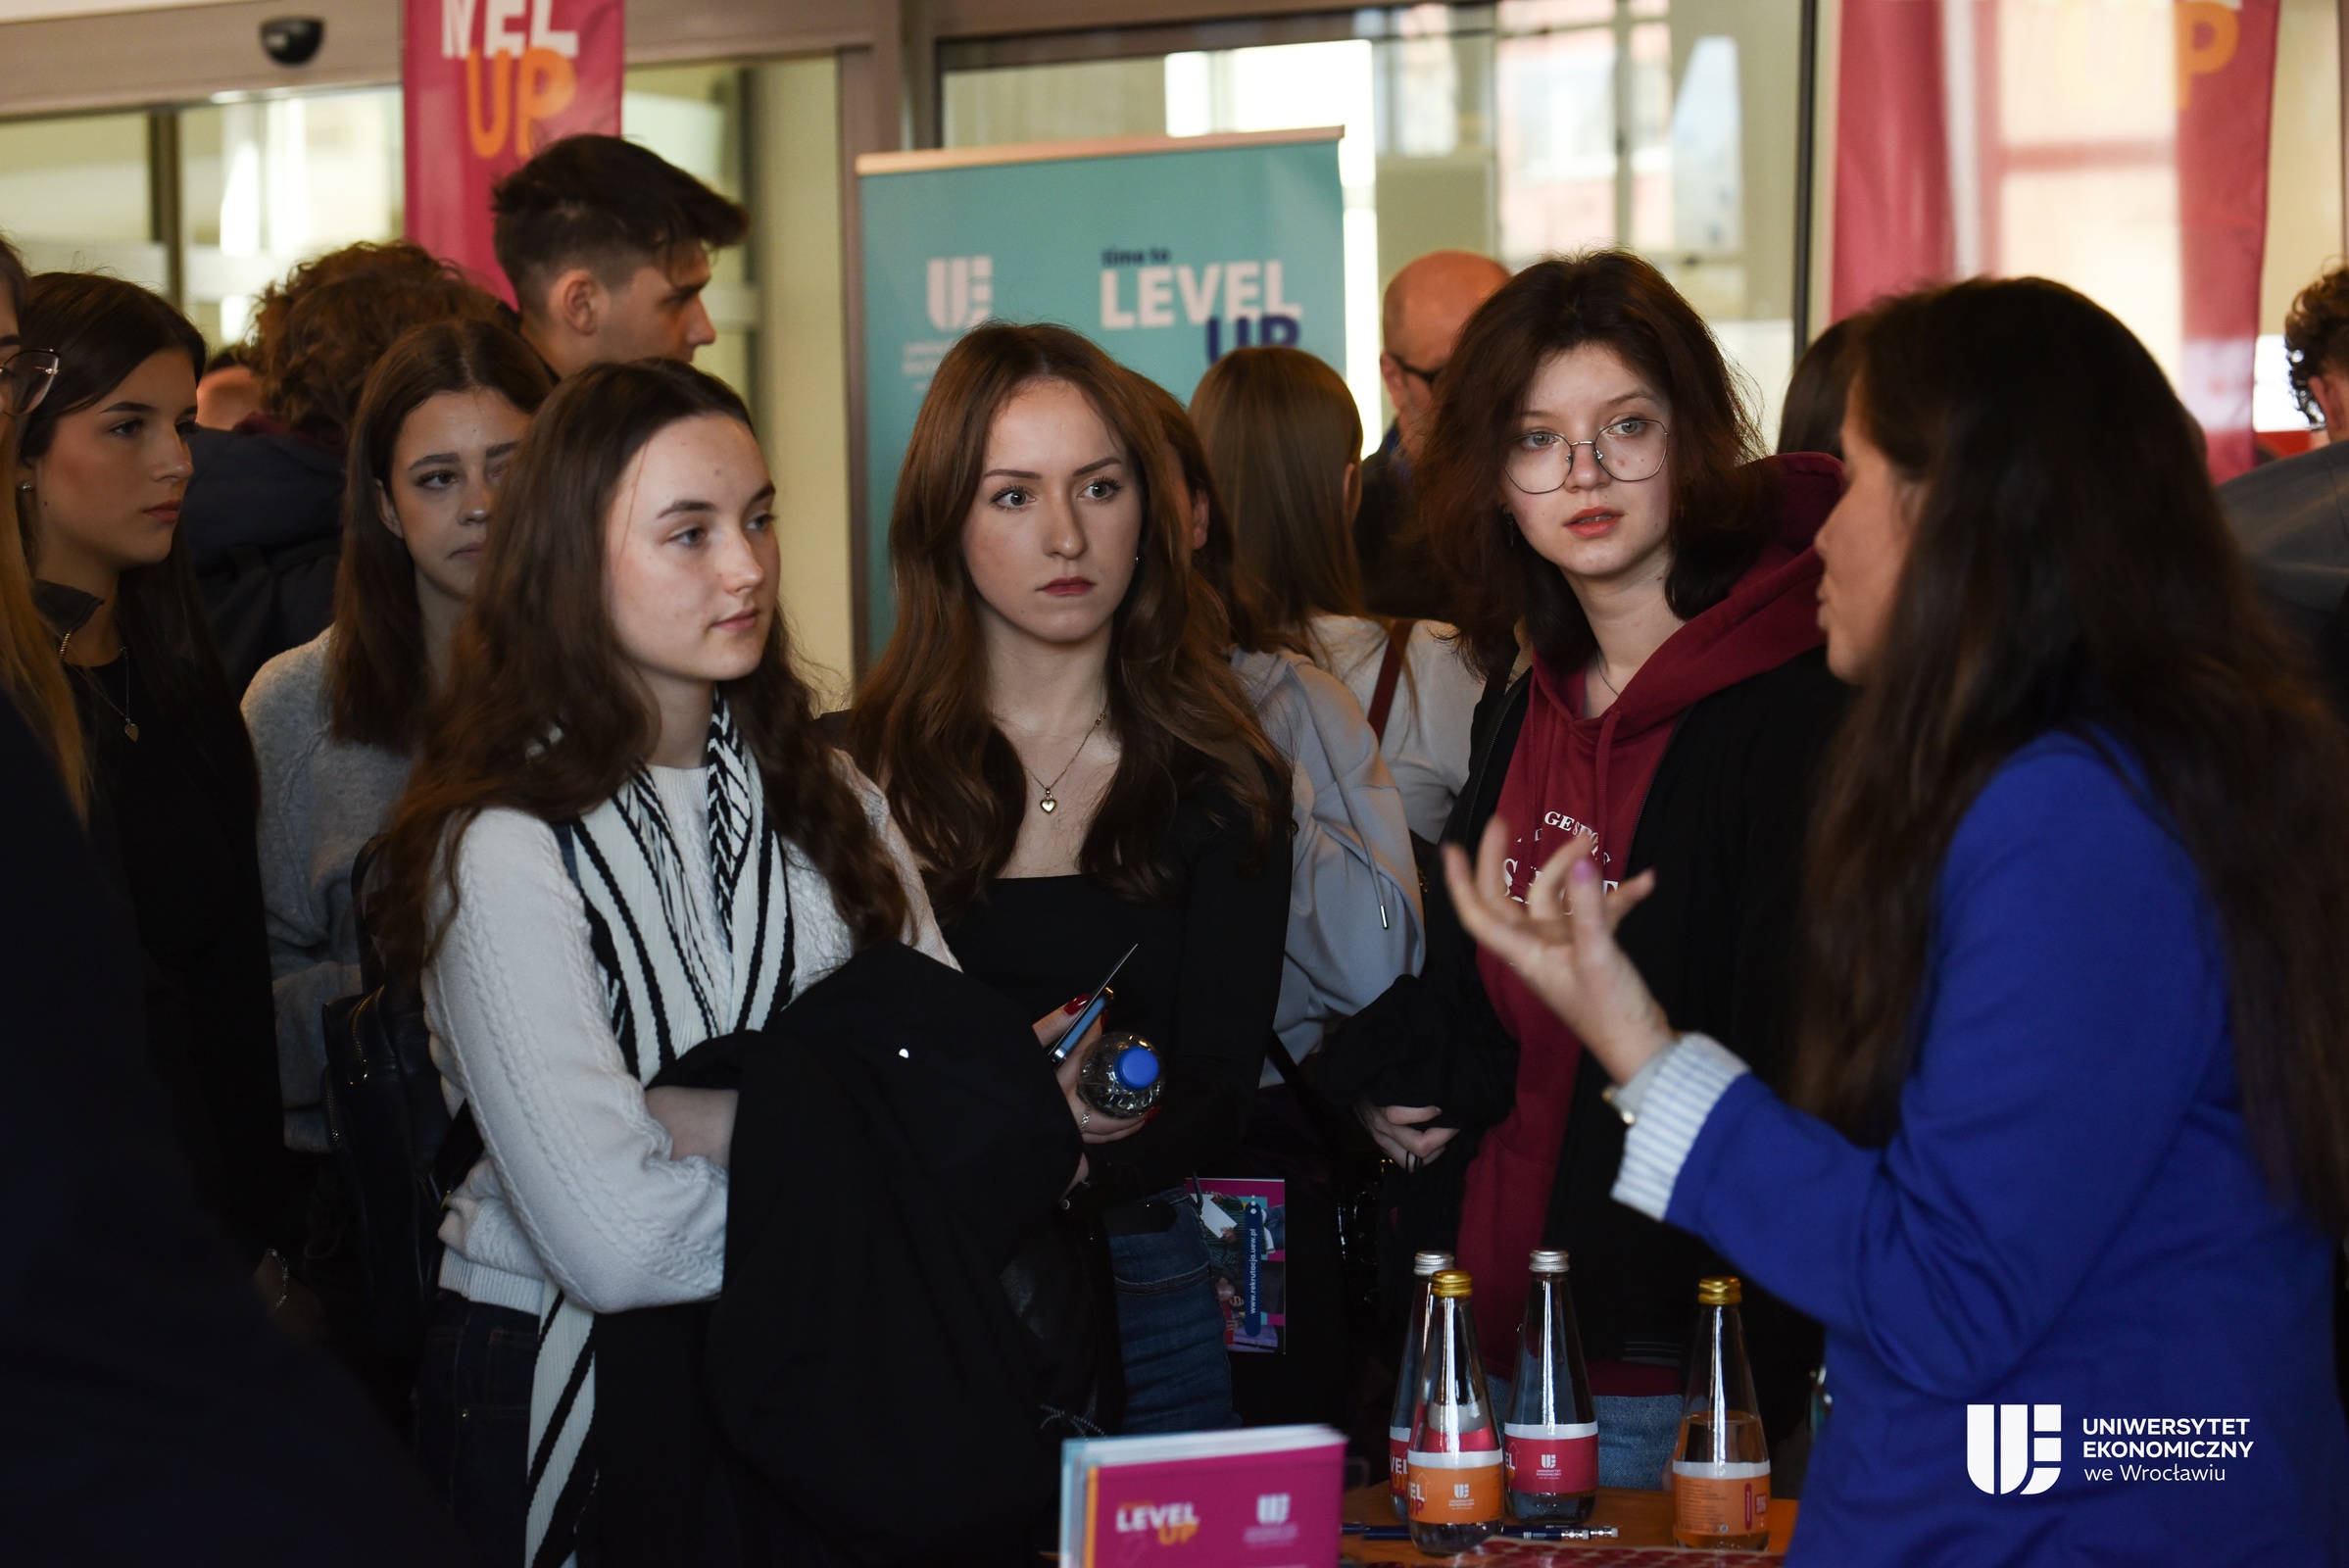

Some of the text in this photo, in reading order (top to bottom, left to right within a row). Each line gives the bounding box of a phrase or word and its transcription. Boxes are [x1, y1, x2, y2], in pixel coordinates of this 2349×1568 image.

[466, 47, 576, 158] UP
[1101, 261, 1301, 330] LEVEL
[1249, 1228, 1258, 1315] www.rekrutacja.uew.pl
[1115, 1501, 1199, 1533] LEVEL
[1158, 1523, 1199, 1546] UP
